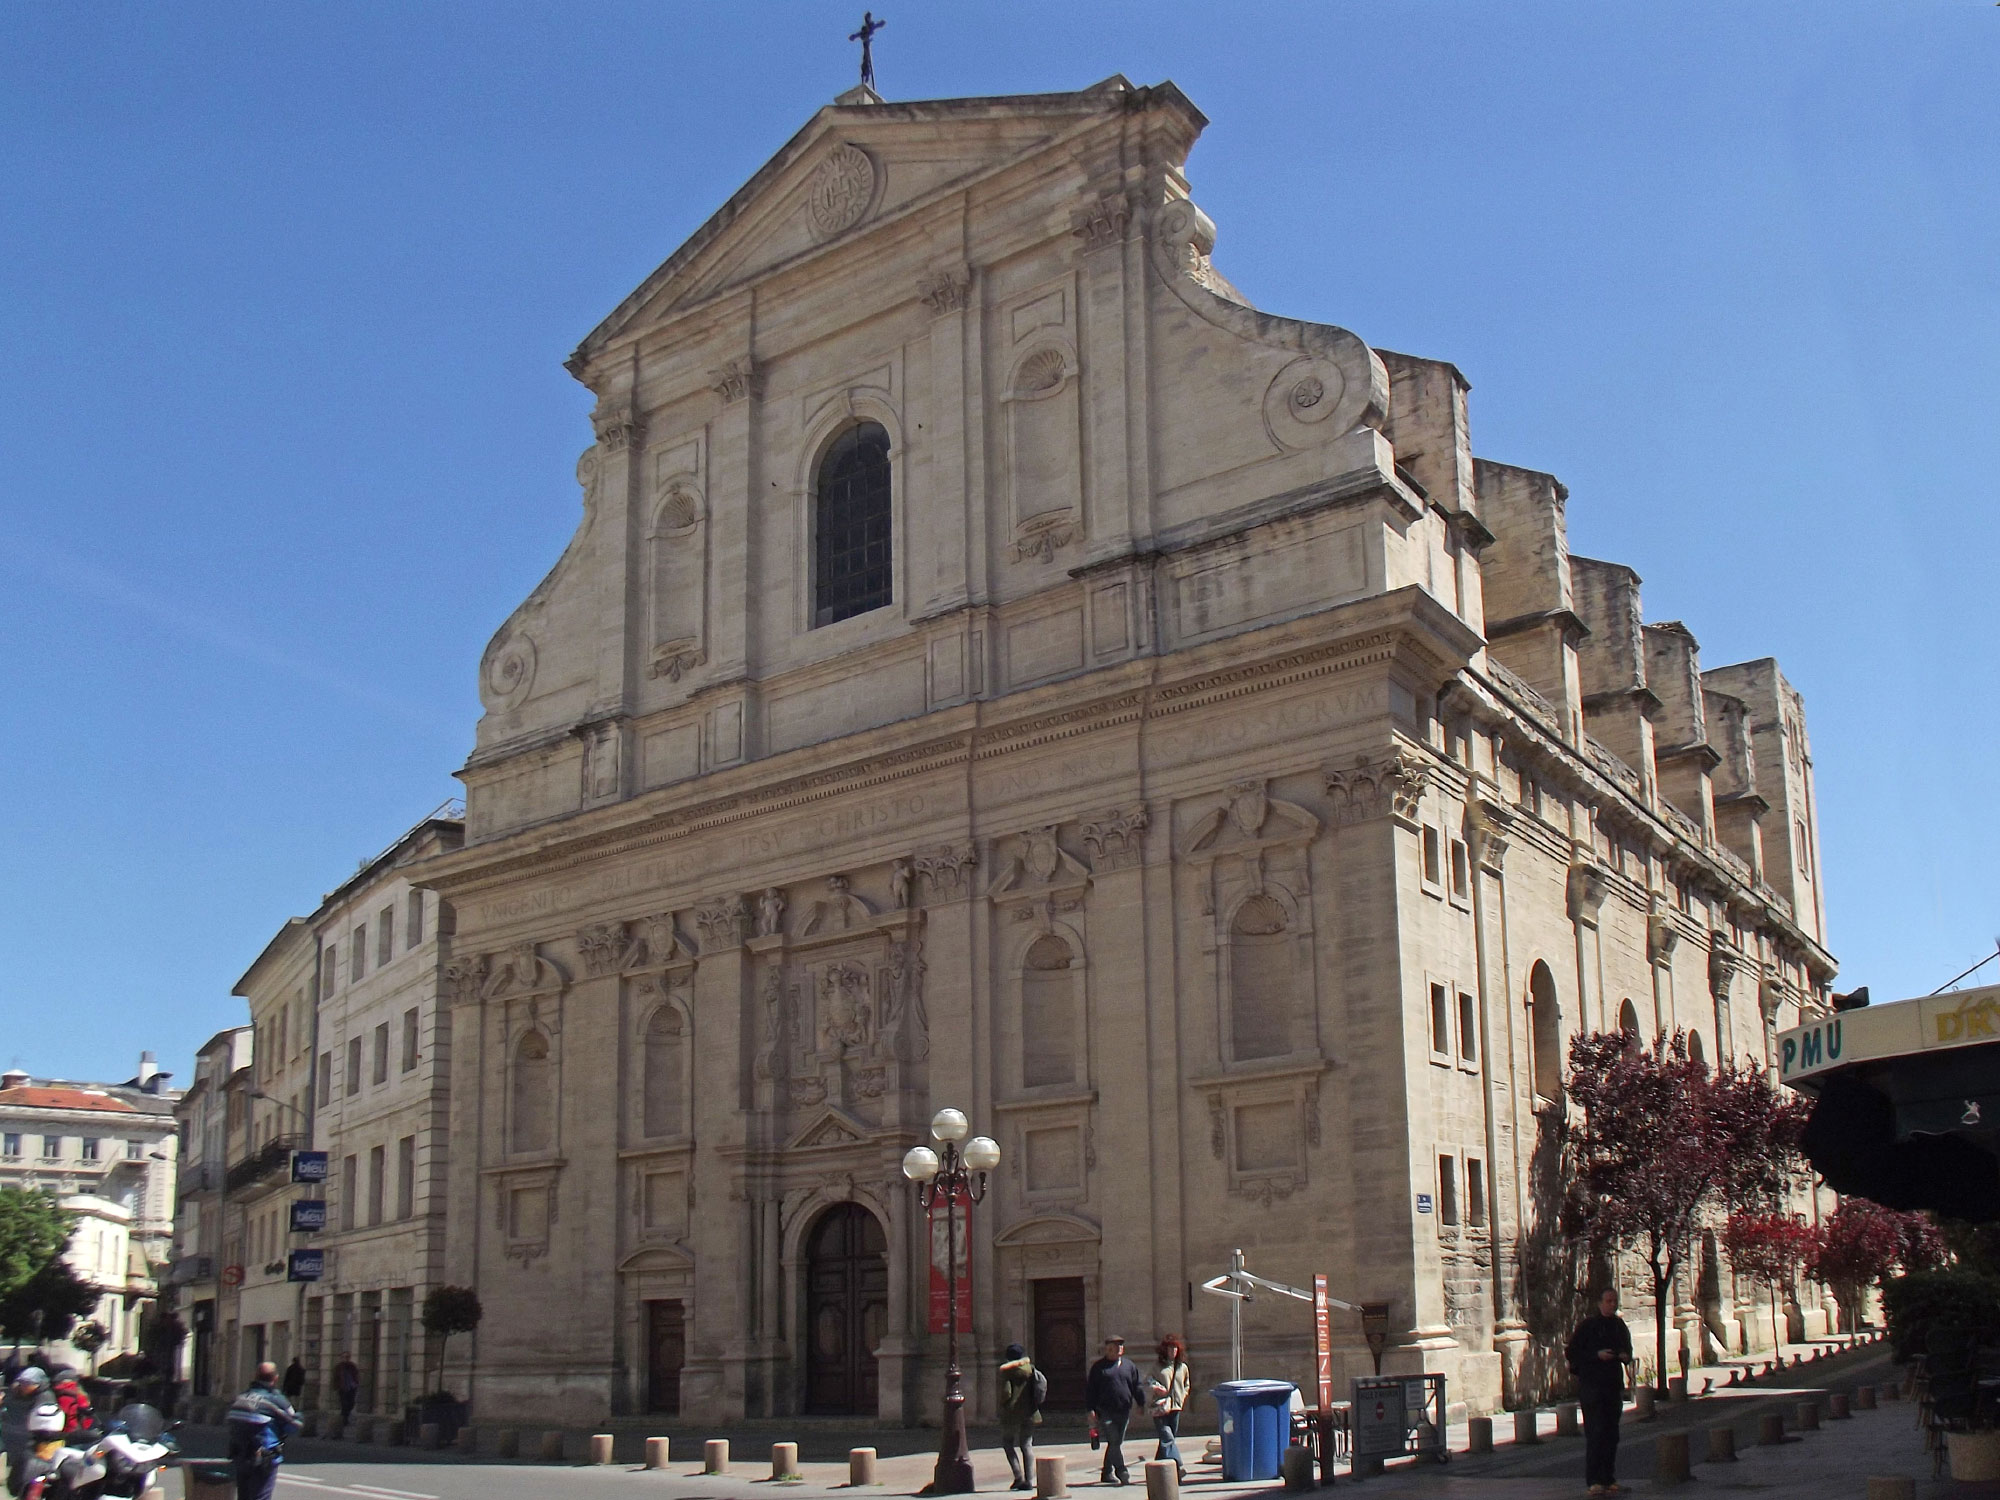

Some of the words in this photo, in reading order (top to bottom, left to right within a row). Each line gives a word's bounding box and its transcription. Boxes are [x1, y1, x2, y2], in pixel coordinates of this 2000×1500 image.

[819, 794, 926, 837] CHRISTO
[1935, 1004, 2000, 1041] DR
[1782, 1018, 1843, 1075] PMU
[298, 1162, 327, 1173] bleu
[297, 1211, 325, 1221] bleu
[295, 1260, 323, 1271] bleu
